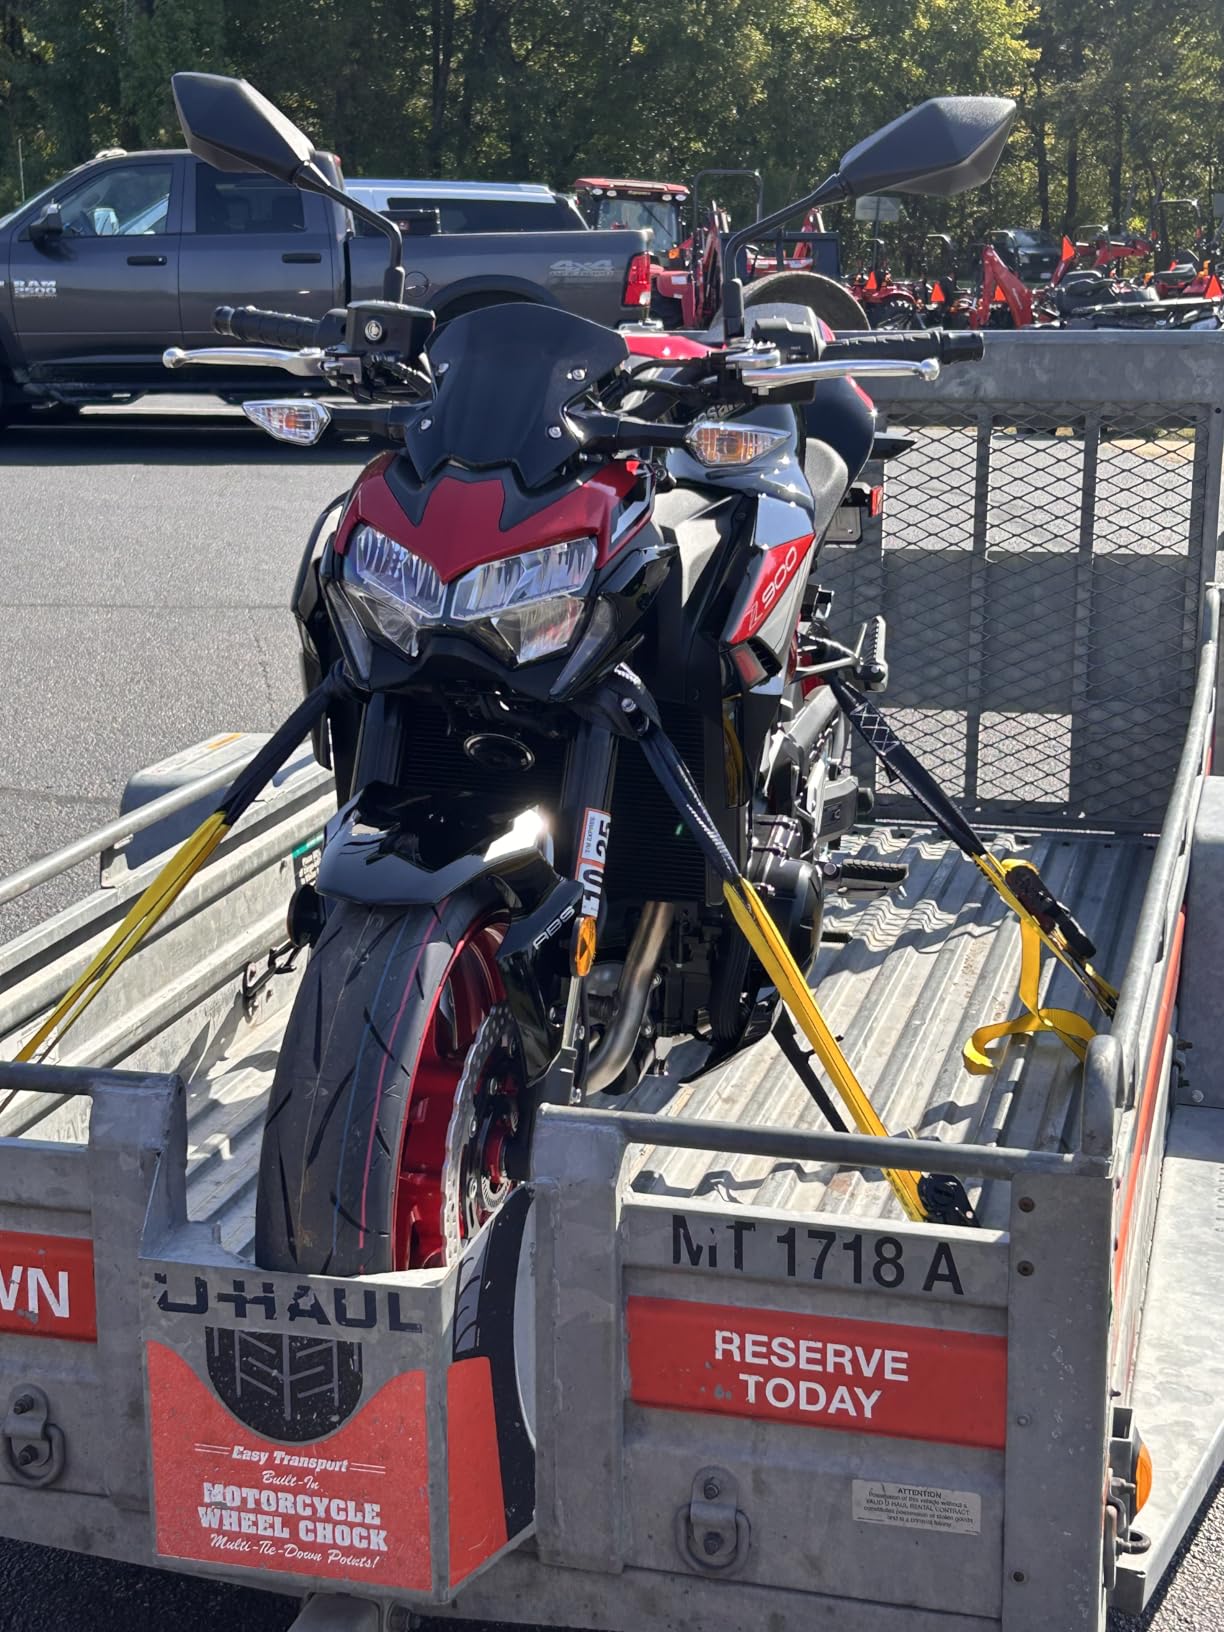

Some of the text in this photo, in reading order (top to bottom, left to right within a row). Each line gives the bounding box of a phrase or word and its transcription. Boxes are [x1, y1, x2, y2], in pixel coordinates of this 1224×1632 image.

[14, 280, 57, 288] RAM
[532, 905, 576, 950] ABS
[776, 1227, 905, 1289] 1718
[921, 1241, 965, 1296] A
[714, 1329, 910, 1382] RESERVE
[738, 1373, 882, 1419] TODAY
[232, 1445, 349, 1473] Easy Transport
[261, 1469, 320, 1490] Built-In
[202, 1482, 382, 1526] MOTORCYCLE
[898, 1487, 942, 1499] ATTENTION
[197, 1506, 389, 1552] WHEEL CHOCK
[327, 1549, 380, 1569] Points!
